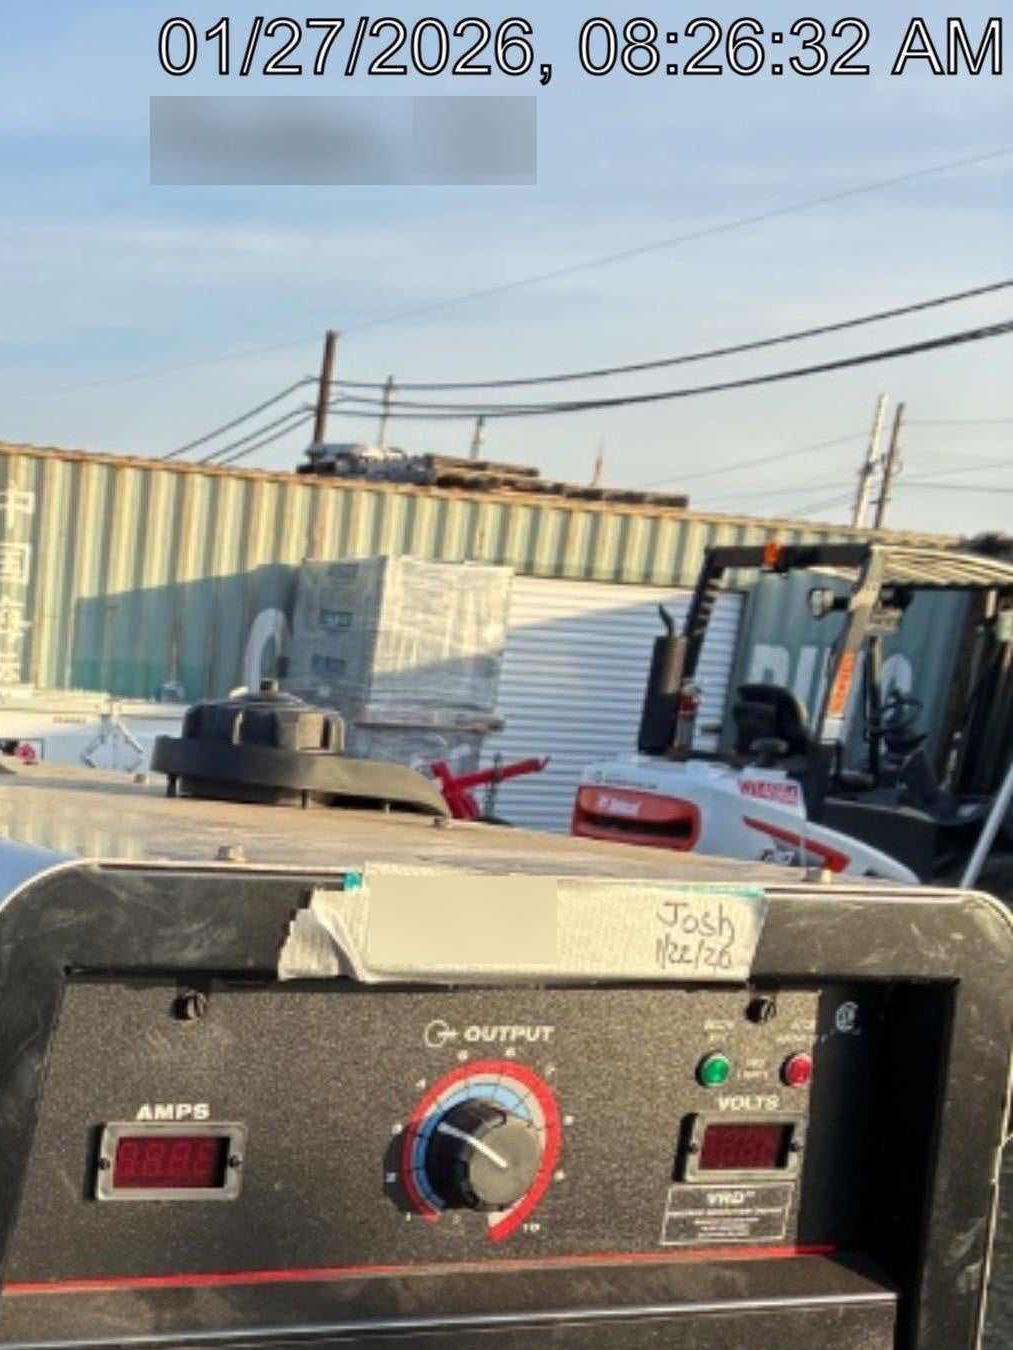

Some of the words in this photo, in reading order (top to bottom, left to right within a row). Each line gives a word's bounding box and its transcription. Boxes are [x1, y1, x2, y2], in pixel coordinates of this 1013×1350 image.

[655, 900, 735, 944] Josh
[463, 1025, 555, 1042] OUTPUT
[135, 1102, 211, 1121] AMPS
[717, 1094, 780, 1111] VOLTS
